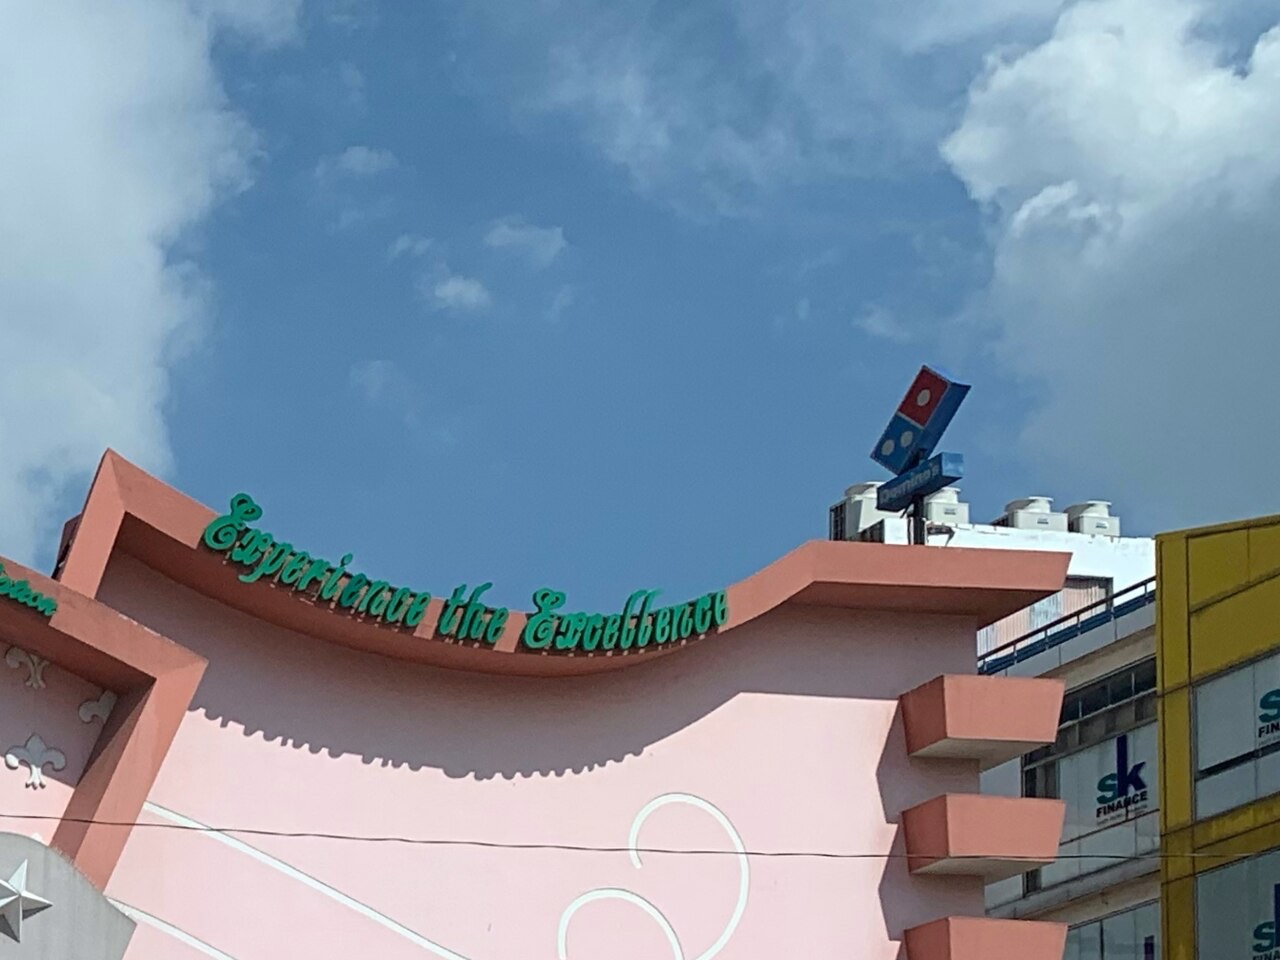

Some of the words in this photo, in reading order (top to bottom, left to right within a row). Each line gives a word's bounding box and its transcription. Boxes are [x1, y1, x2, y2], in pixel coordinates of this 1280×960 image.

[203, 492, 432, 628] Experience
[438, 582, 510, 644] the
[524, 587, 730, 652] Excellence
[1096, 790, 1148, 818] FINANCE
